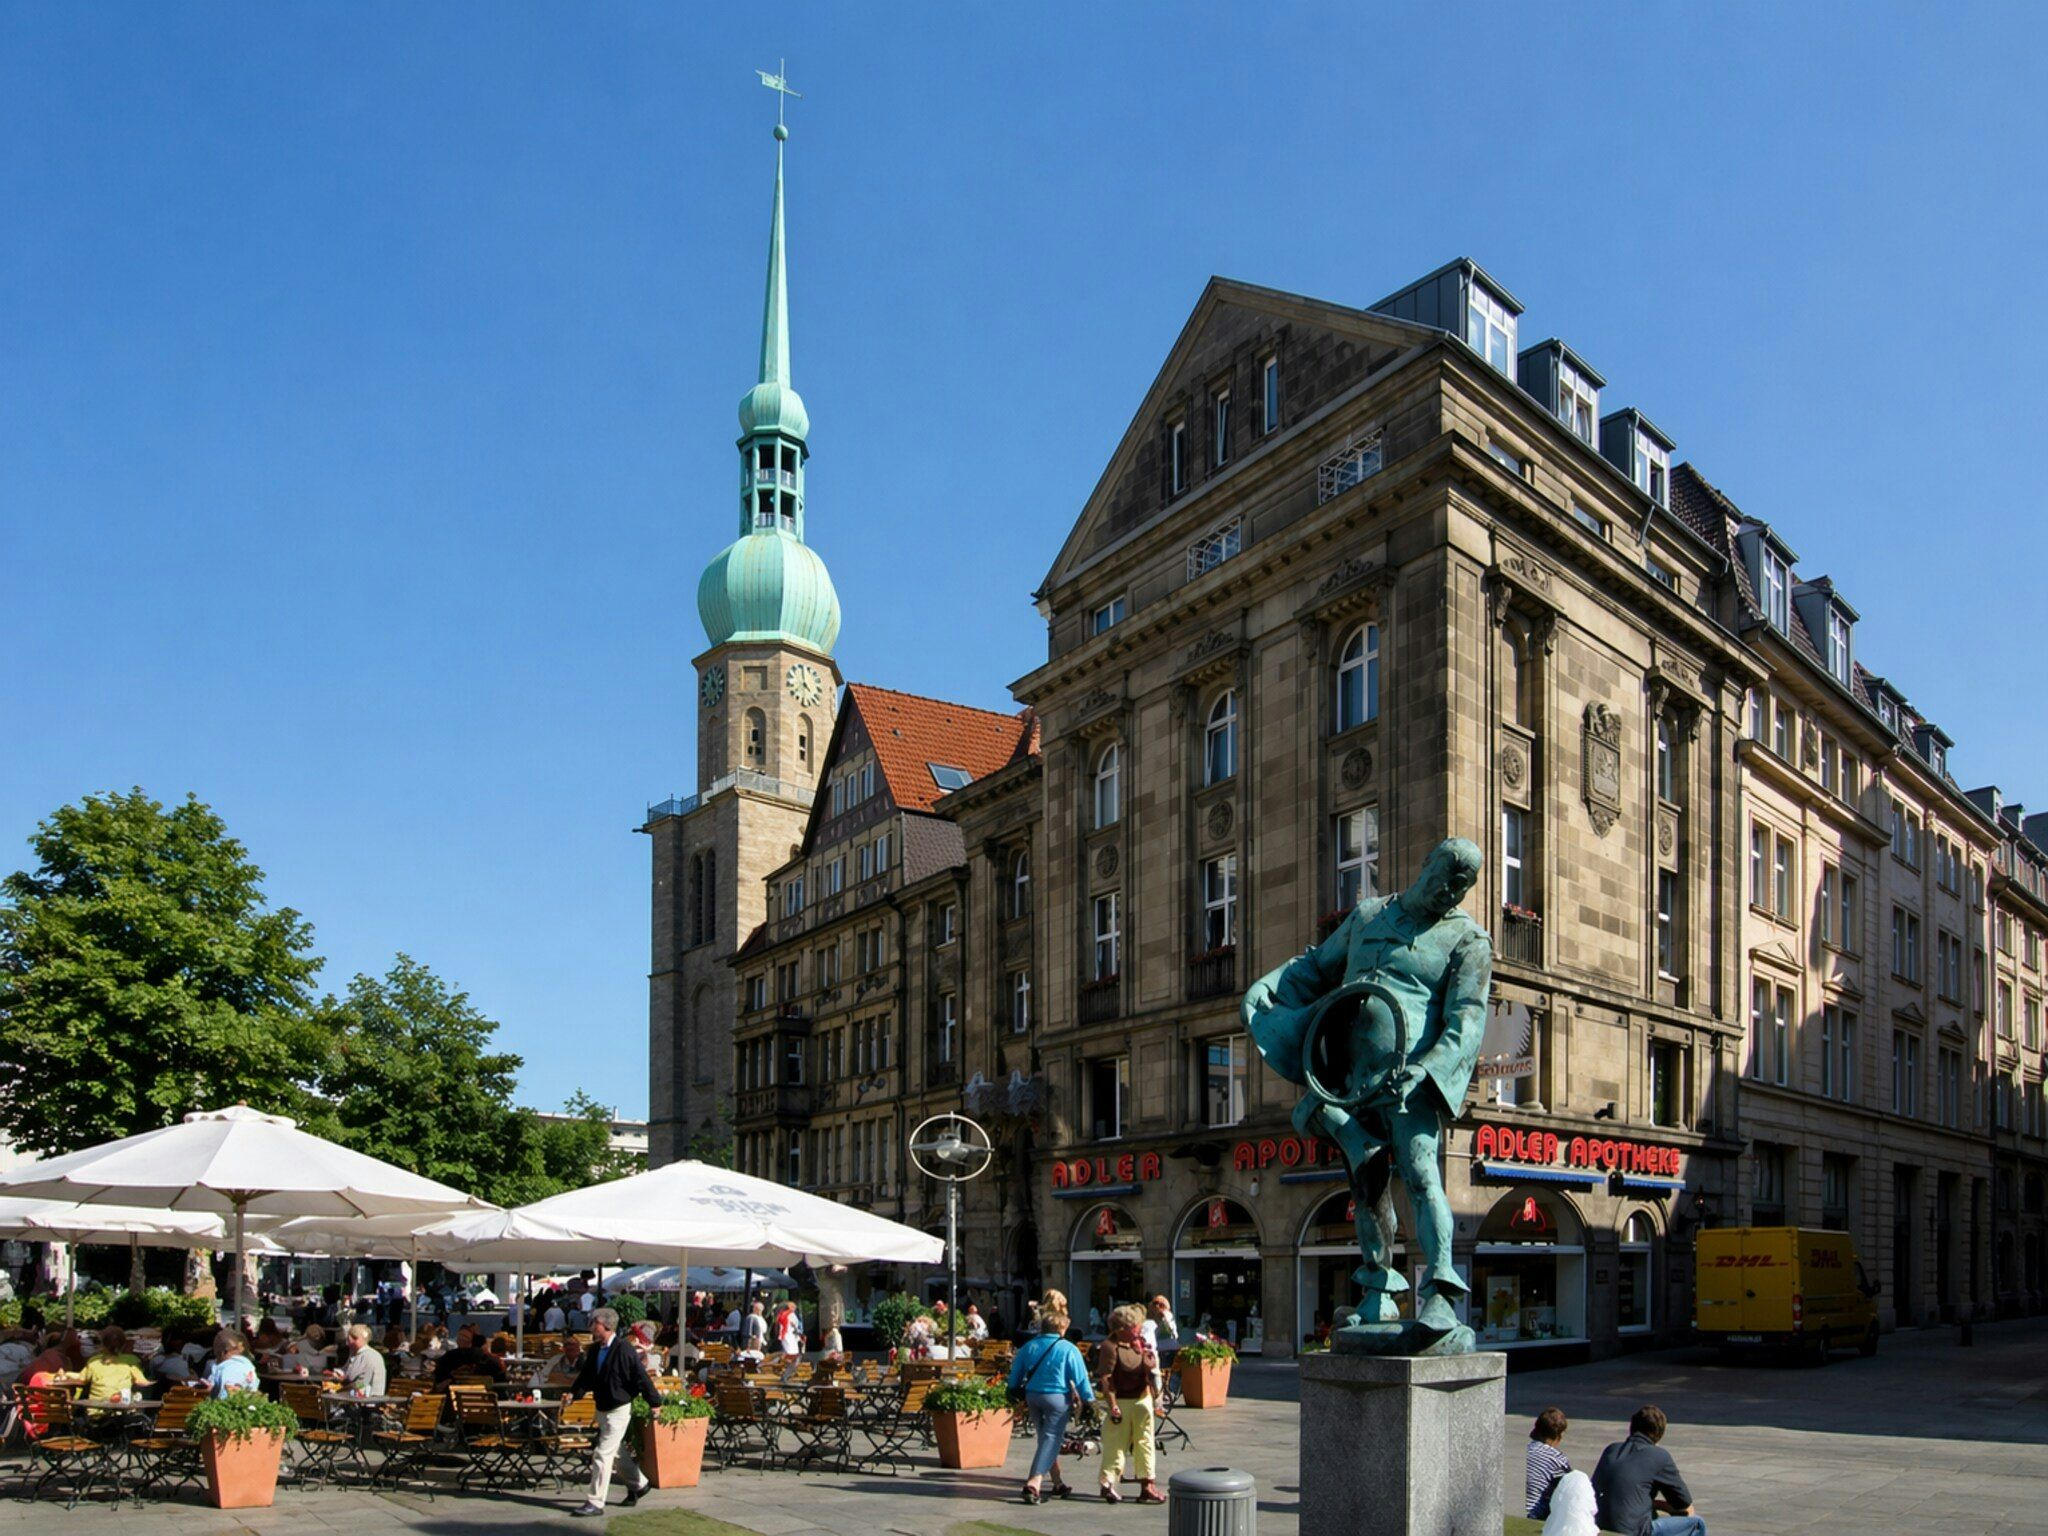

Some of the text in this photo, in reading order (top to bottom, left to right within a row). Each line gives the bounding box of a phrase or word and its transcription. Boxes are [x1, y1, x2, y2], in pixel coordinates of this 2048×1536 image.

[1052, 1136, 1342, 1188] ADLER APOT
[1477, 1124, 1681, 1175] ADLER APOTHEKE
[1715, 1255, 1776, 1268] DHL
[1810, 1249, 1843, 1269] DHL
